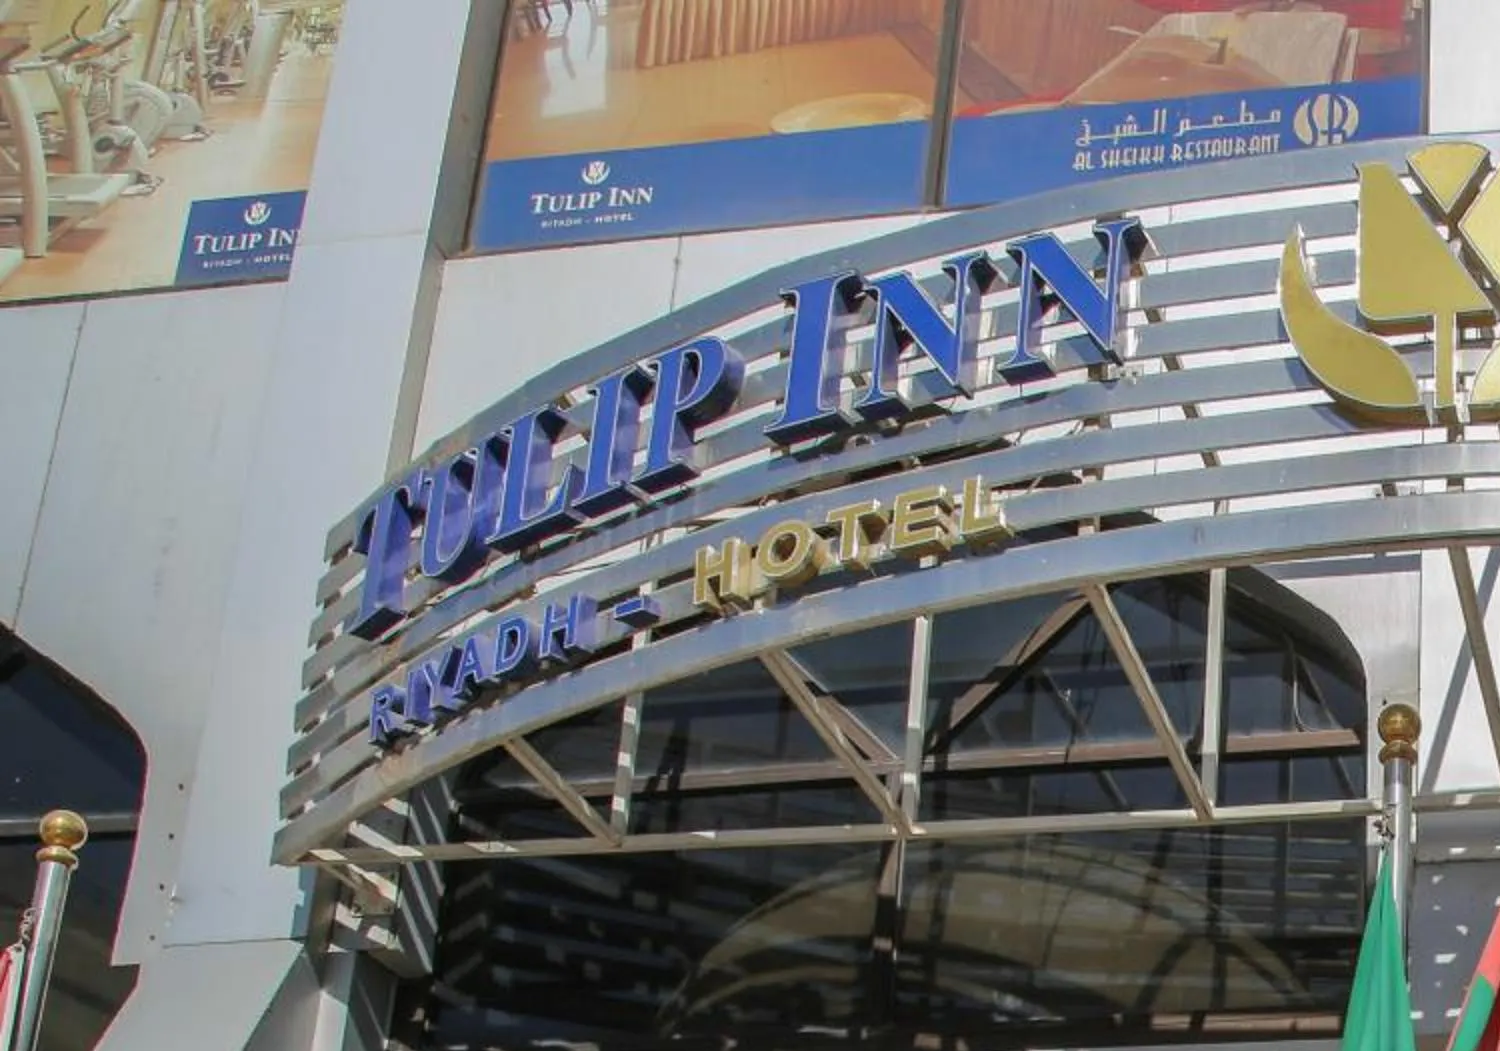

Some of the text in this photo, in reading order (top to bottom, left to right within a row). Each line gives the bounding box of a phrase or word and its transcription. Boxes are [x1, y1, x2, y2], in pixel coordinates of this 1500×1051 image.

[1075, 100, 1281, 147] مطعم الشيخ
[1072, 133, 1281, 172] AL SHEIKH RESTAURANT
[531, 186, 654, 215] TULIP INN
[193, 227, 301, 255] TULIP IN
[349, 217, 1146, 640] TULIP INN
[368, 591, 590, 746] RIYADH
[692, 476, 1008, 608] HOTEL
